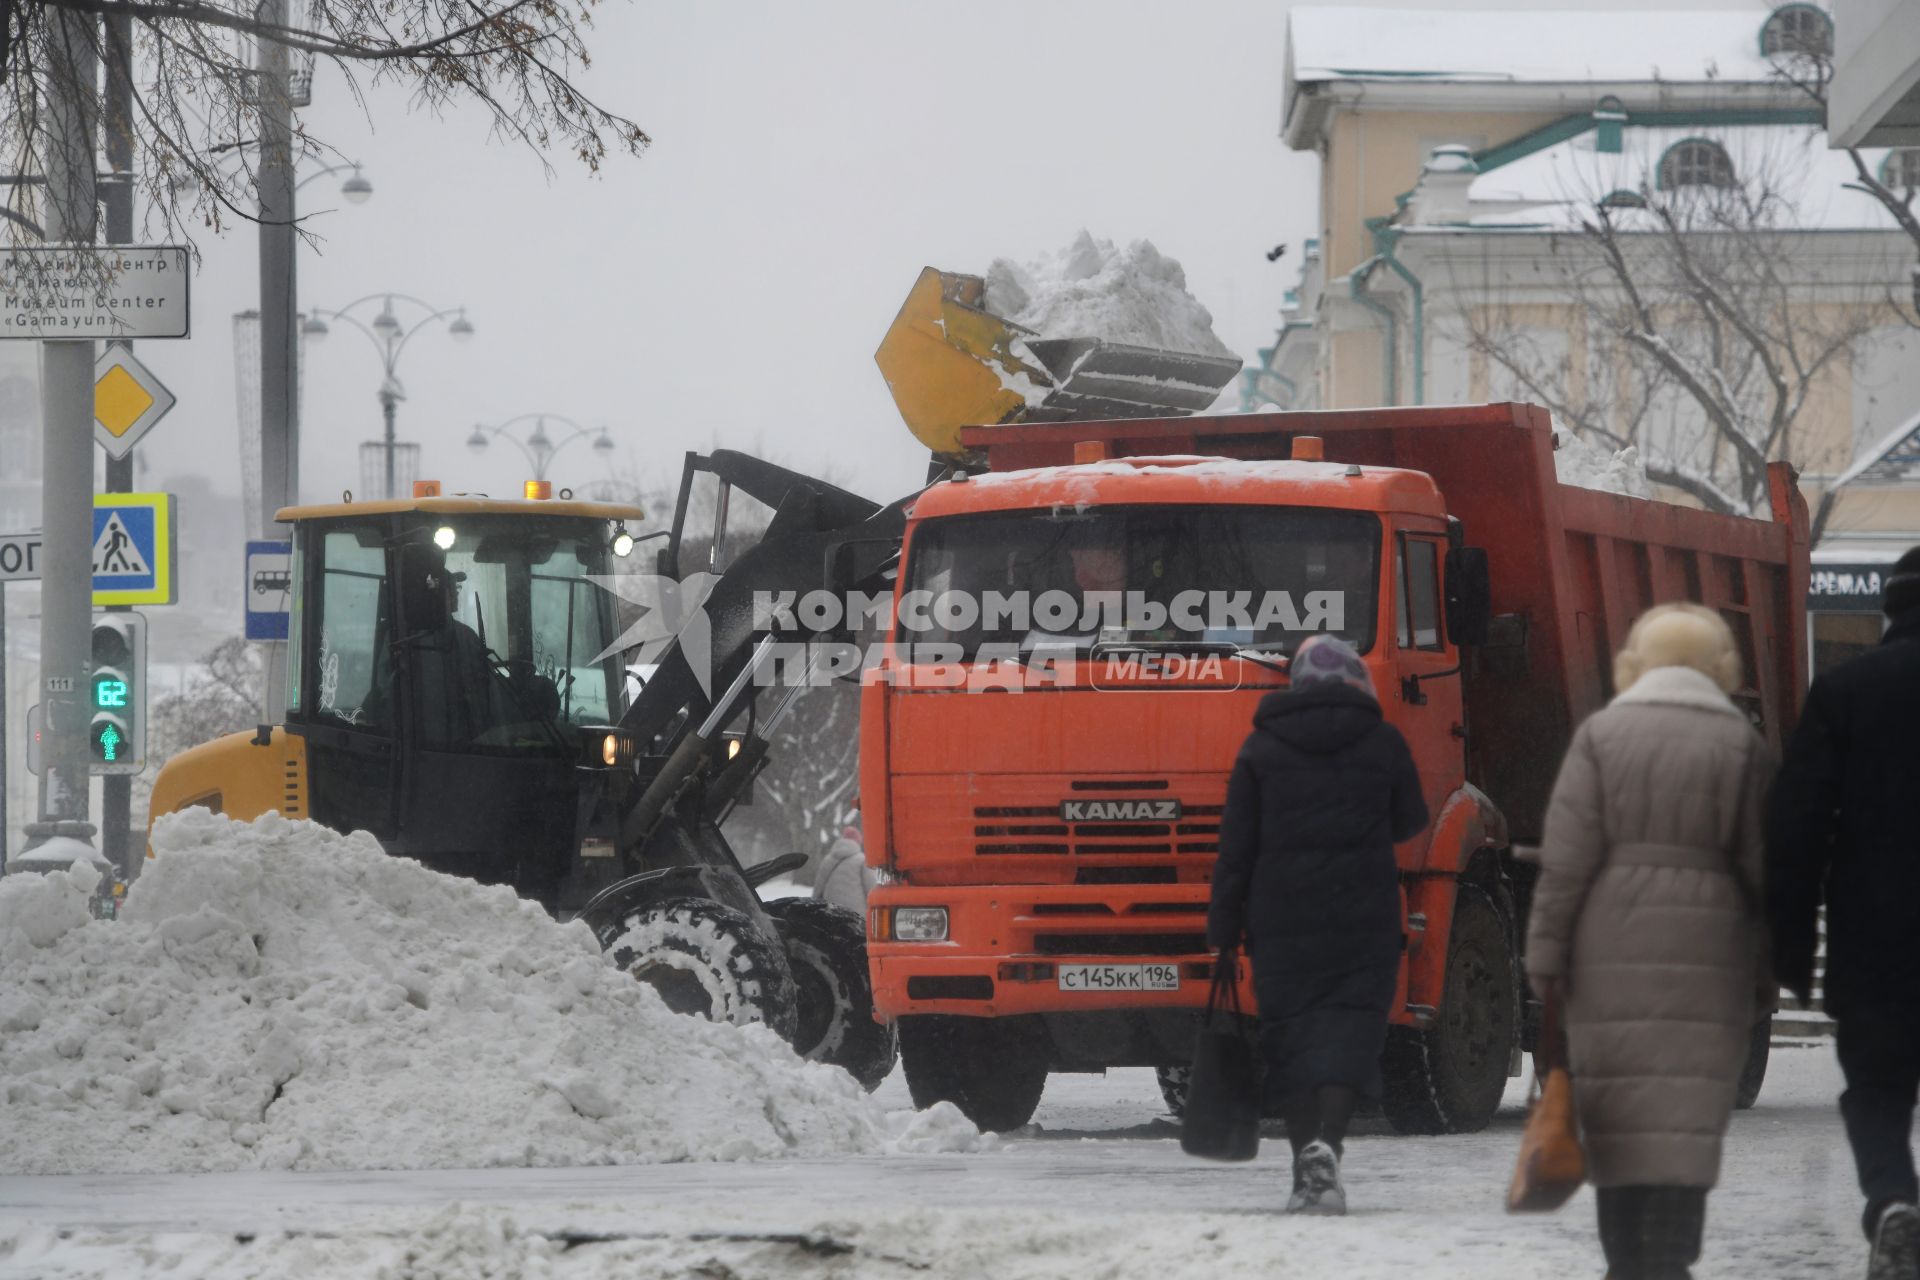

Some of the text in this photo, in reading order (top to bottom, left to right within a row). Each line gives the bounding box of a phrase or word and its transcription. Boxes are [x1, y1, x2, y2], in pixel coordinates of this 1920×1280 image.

[111, 259, 168, 273] центр
[5, 297, 166, 309] Museum Center
[97, 681, 127, 706] 62
[1064, 802, 1177, 820] KAMAZ
[1144, 966, 1173, 982] 196
